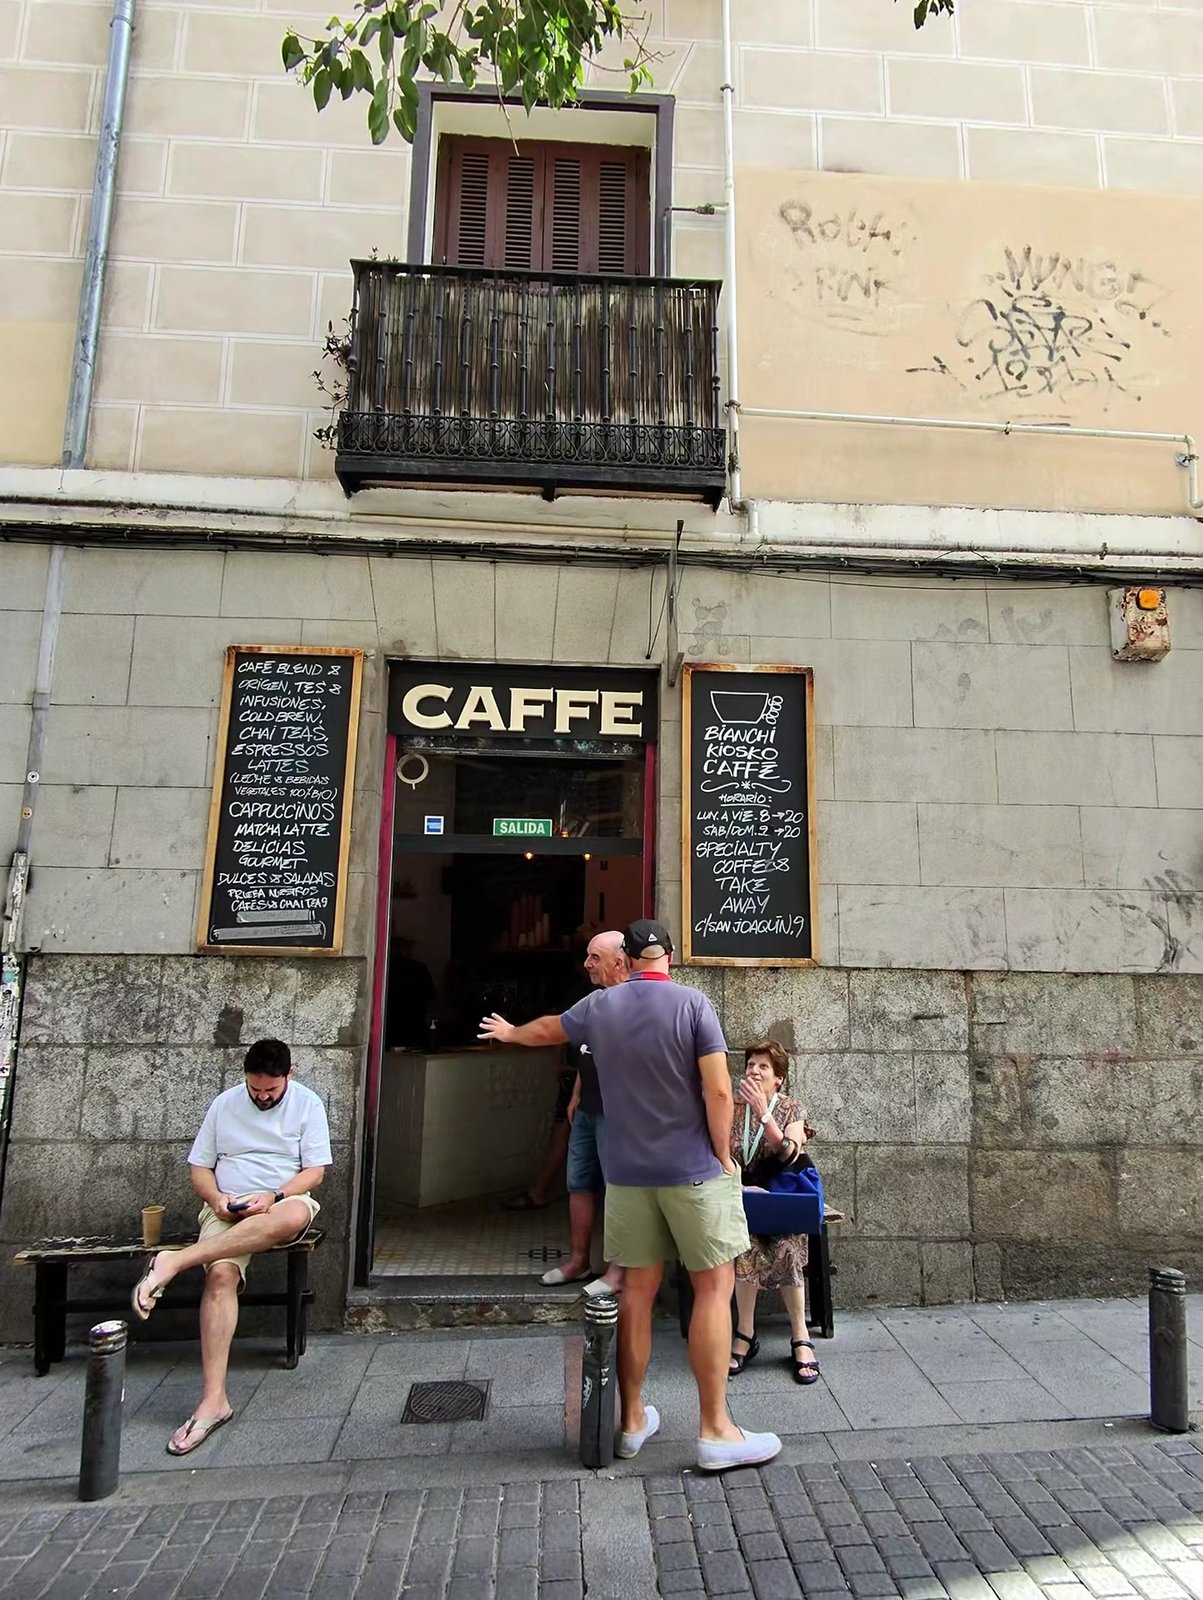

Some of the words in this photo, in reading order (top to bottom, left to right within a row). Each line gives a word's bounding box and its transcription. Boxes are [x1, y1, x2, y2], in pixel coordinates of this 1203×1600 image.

[276, 663, 323, 676] BLEND
[238, 678, 292, 695] ORIGEN,
[239, 694, 327, 711] INFUSIONES,
[402, 683, 644, 738] CAFFE
[239, 709, 275, 722] COLD
[239, 725, 277, 740] CHAI
[280, 725, 329, 743] TEAS,
[703, 724, 777, 744] BIANCHI
[231, 743, 329, 757] ESPRESSOS
[706, 742, 779, 761] KIOSKO
[247, 759, 309, 773] LATTES
[229, 772, 272, 785] (LECHE
[284, 775, 330, 785] BEBIDAS
[234, 786, 288, 796] VEGETALES
[718, 792, 773, 804] HORARIO:
[228, 801, 335, 821] CAPPUCCINOS
[721, 810, 729, 822] A
[759, 809, 771, 823] 8
[784, 809, 804, 824] 20
[234, 822, 281, 837] MATCHA
[283, 823, 331, 837] LATTE
[499, 821, 546, 835] SALIDA
[783, 824, 801, 838] 20
[232, 839, 306, 855] DELICIAS
[696, 840, 782, 860] SPECIALTY
[238, 854, 309, 870] GOURMET
[217, 872, 267, 886] DULCES
[282, 871, 336, 888] SALADAS
[715, 876, 770, 894] TAKE
[227, 888, 266, 900] PRUEBA
[268, 886, 319, 898] NUESTROS
[719, 894, 770, 914] AWAY
